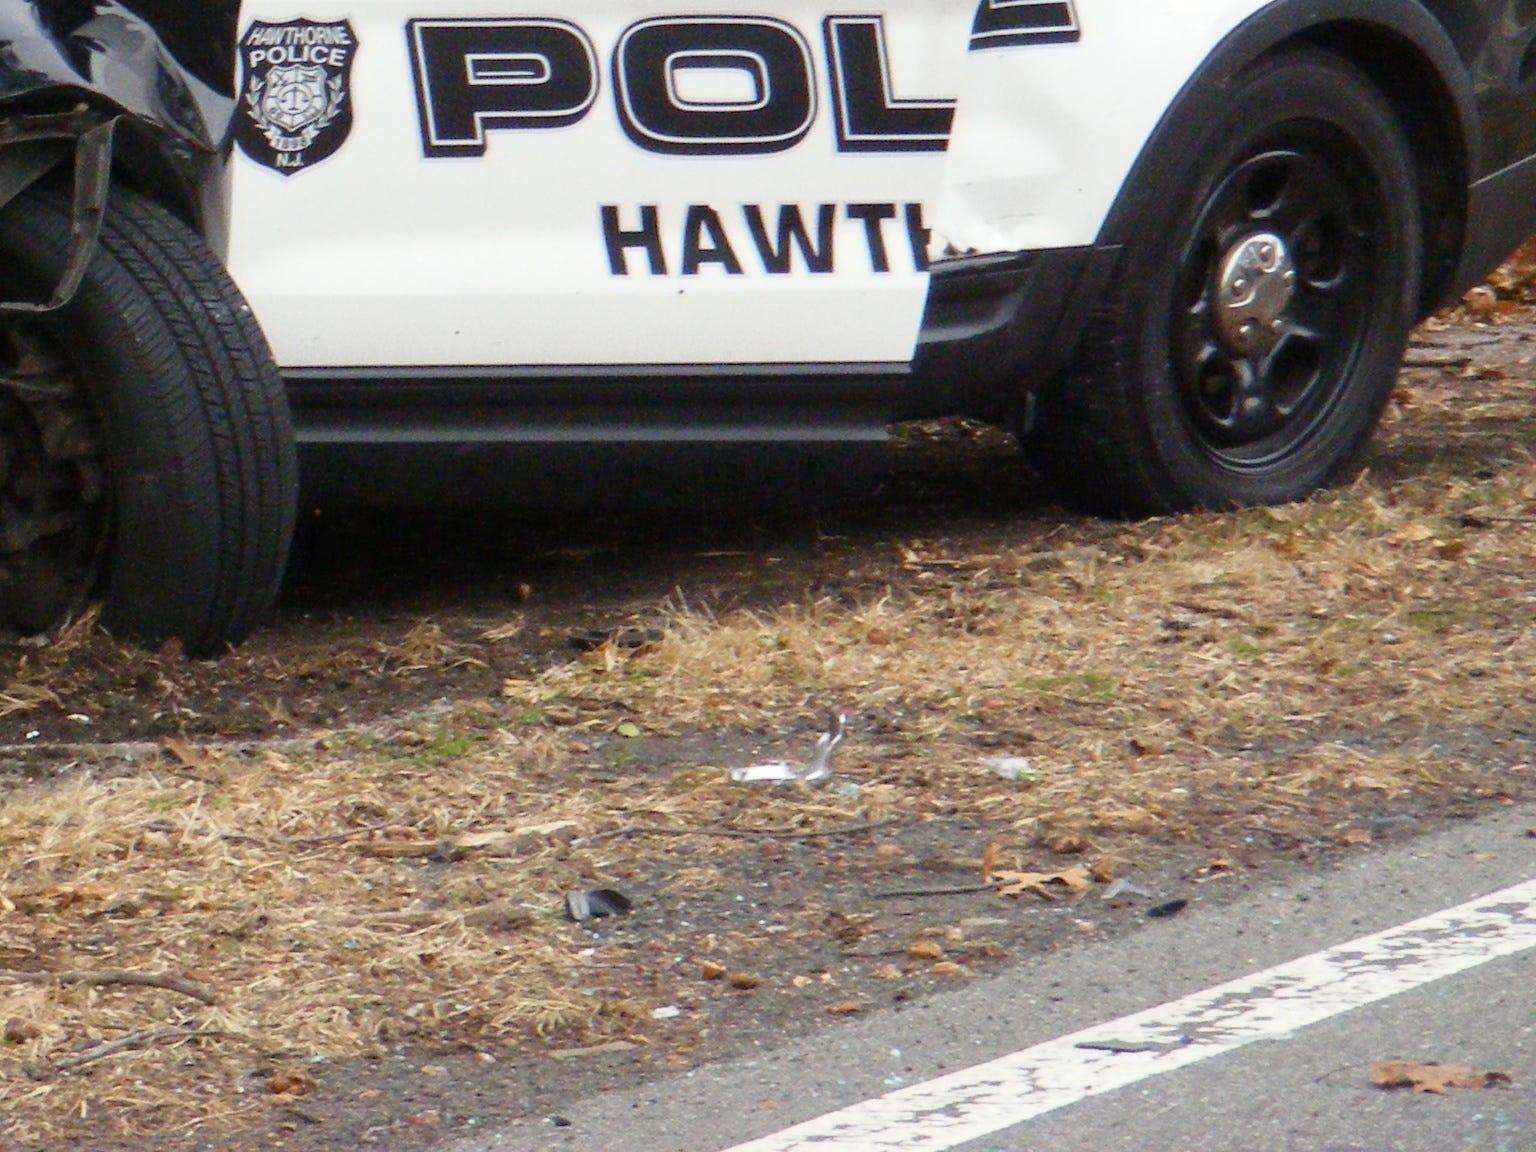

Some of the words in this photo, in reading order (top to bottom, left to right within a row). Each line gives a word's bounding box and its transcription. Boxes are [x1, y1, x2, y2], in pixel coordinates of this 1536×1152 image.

[246, 26, 352, 46] HAWTHORNE
[249, 46, 347, 68] POLICE
[405, 14, 958, 159] POL
